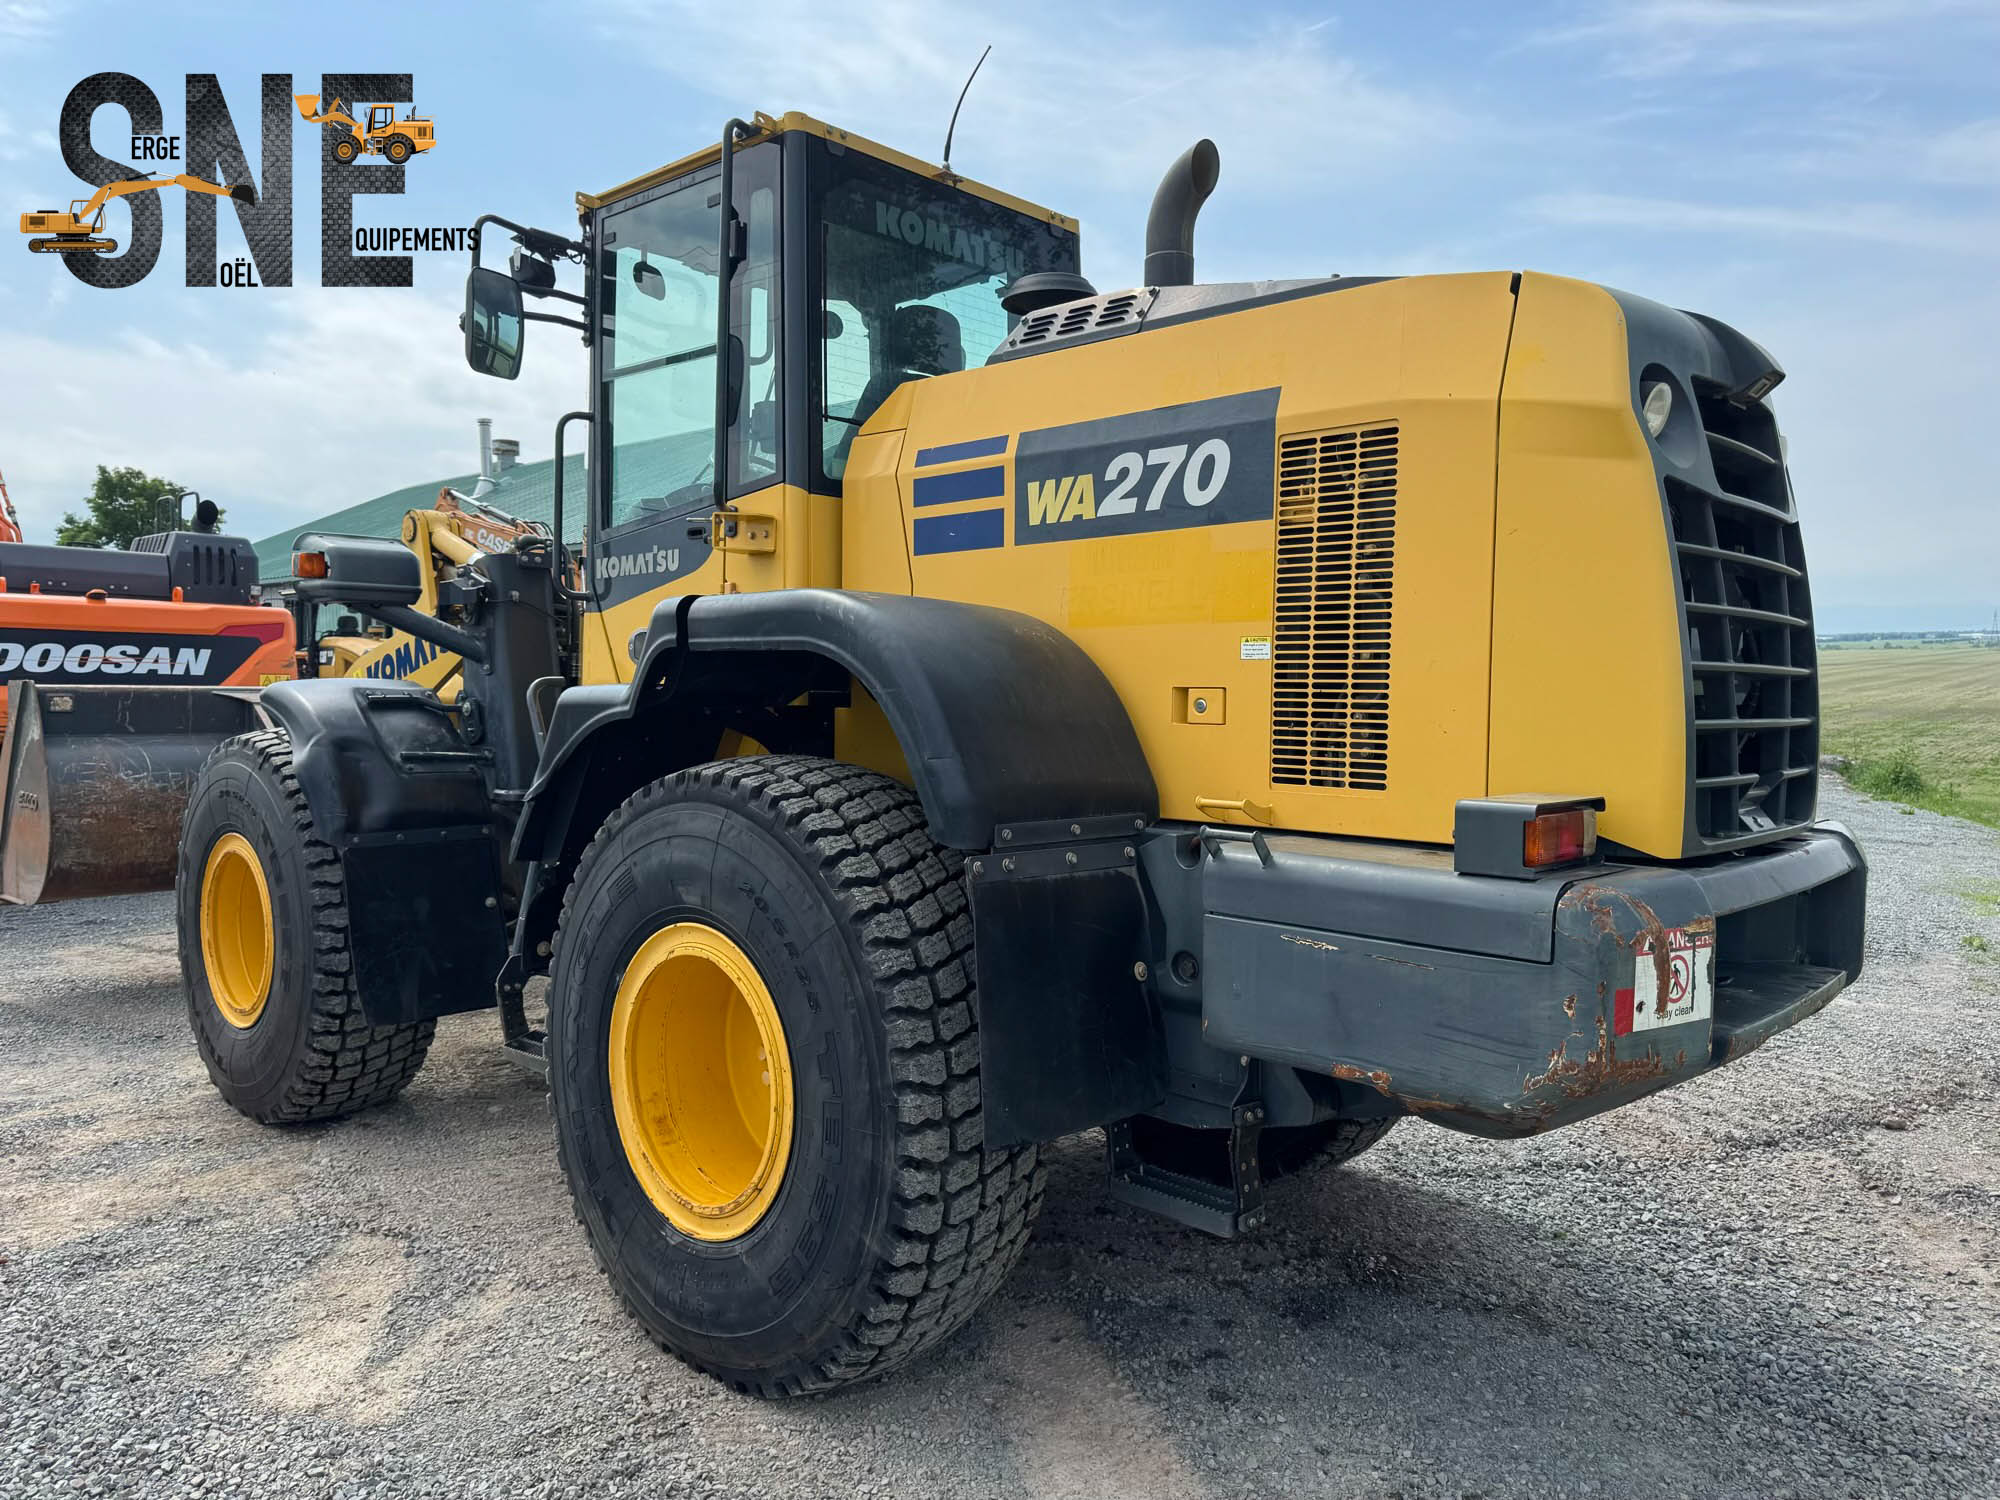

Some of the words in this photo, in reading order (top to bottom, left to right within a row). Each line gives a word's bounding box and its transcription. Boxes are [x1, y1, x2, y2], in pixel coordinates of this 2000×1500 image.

[875, 200, 1025, 276] KOMATSU
[1027, 438, 1231, 526] WA270
[595, 545, 680, 579] KOMATSU
[0, 642, 212, 676] DOOSAN
[366, 639, 449, 680] KOMAT
